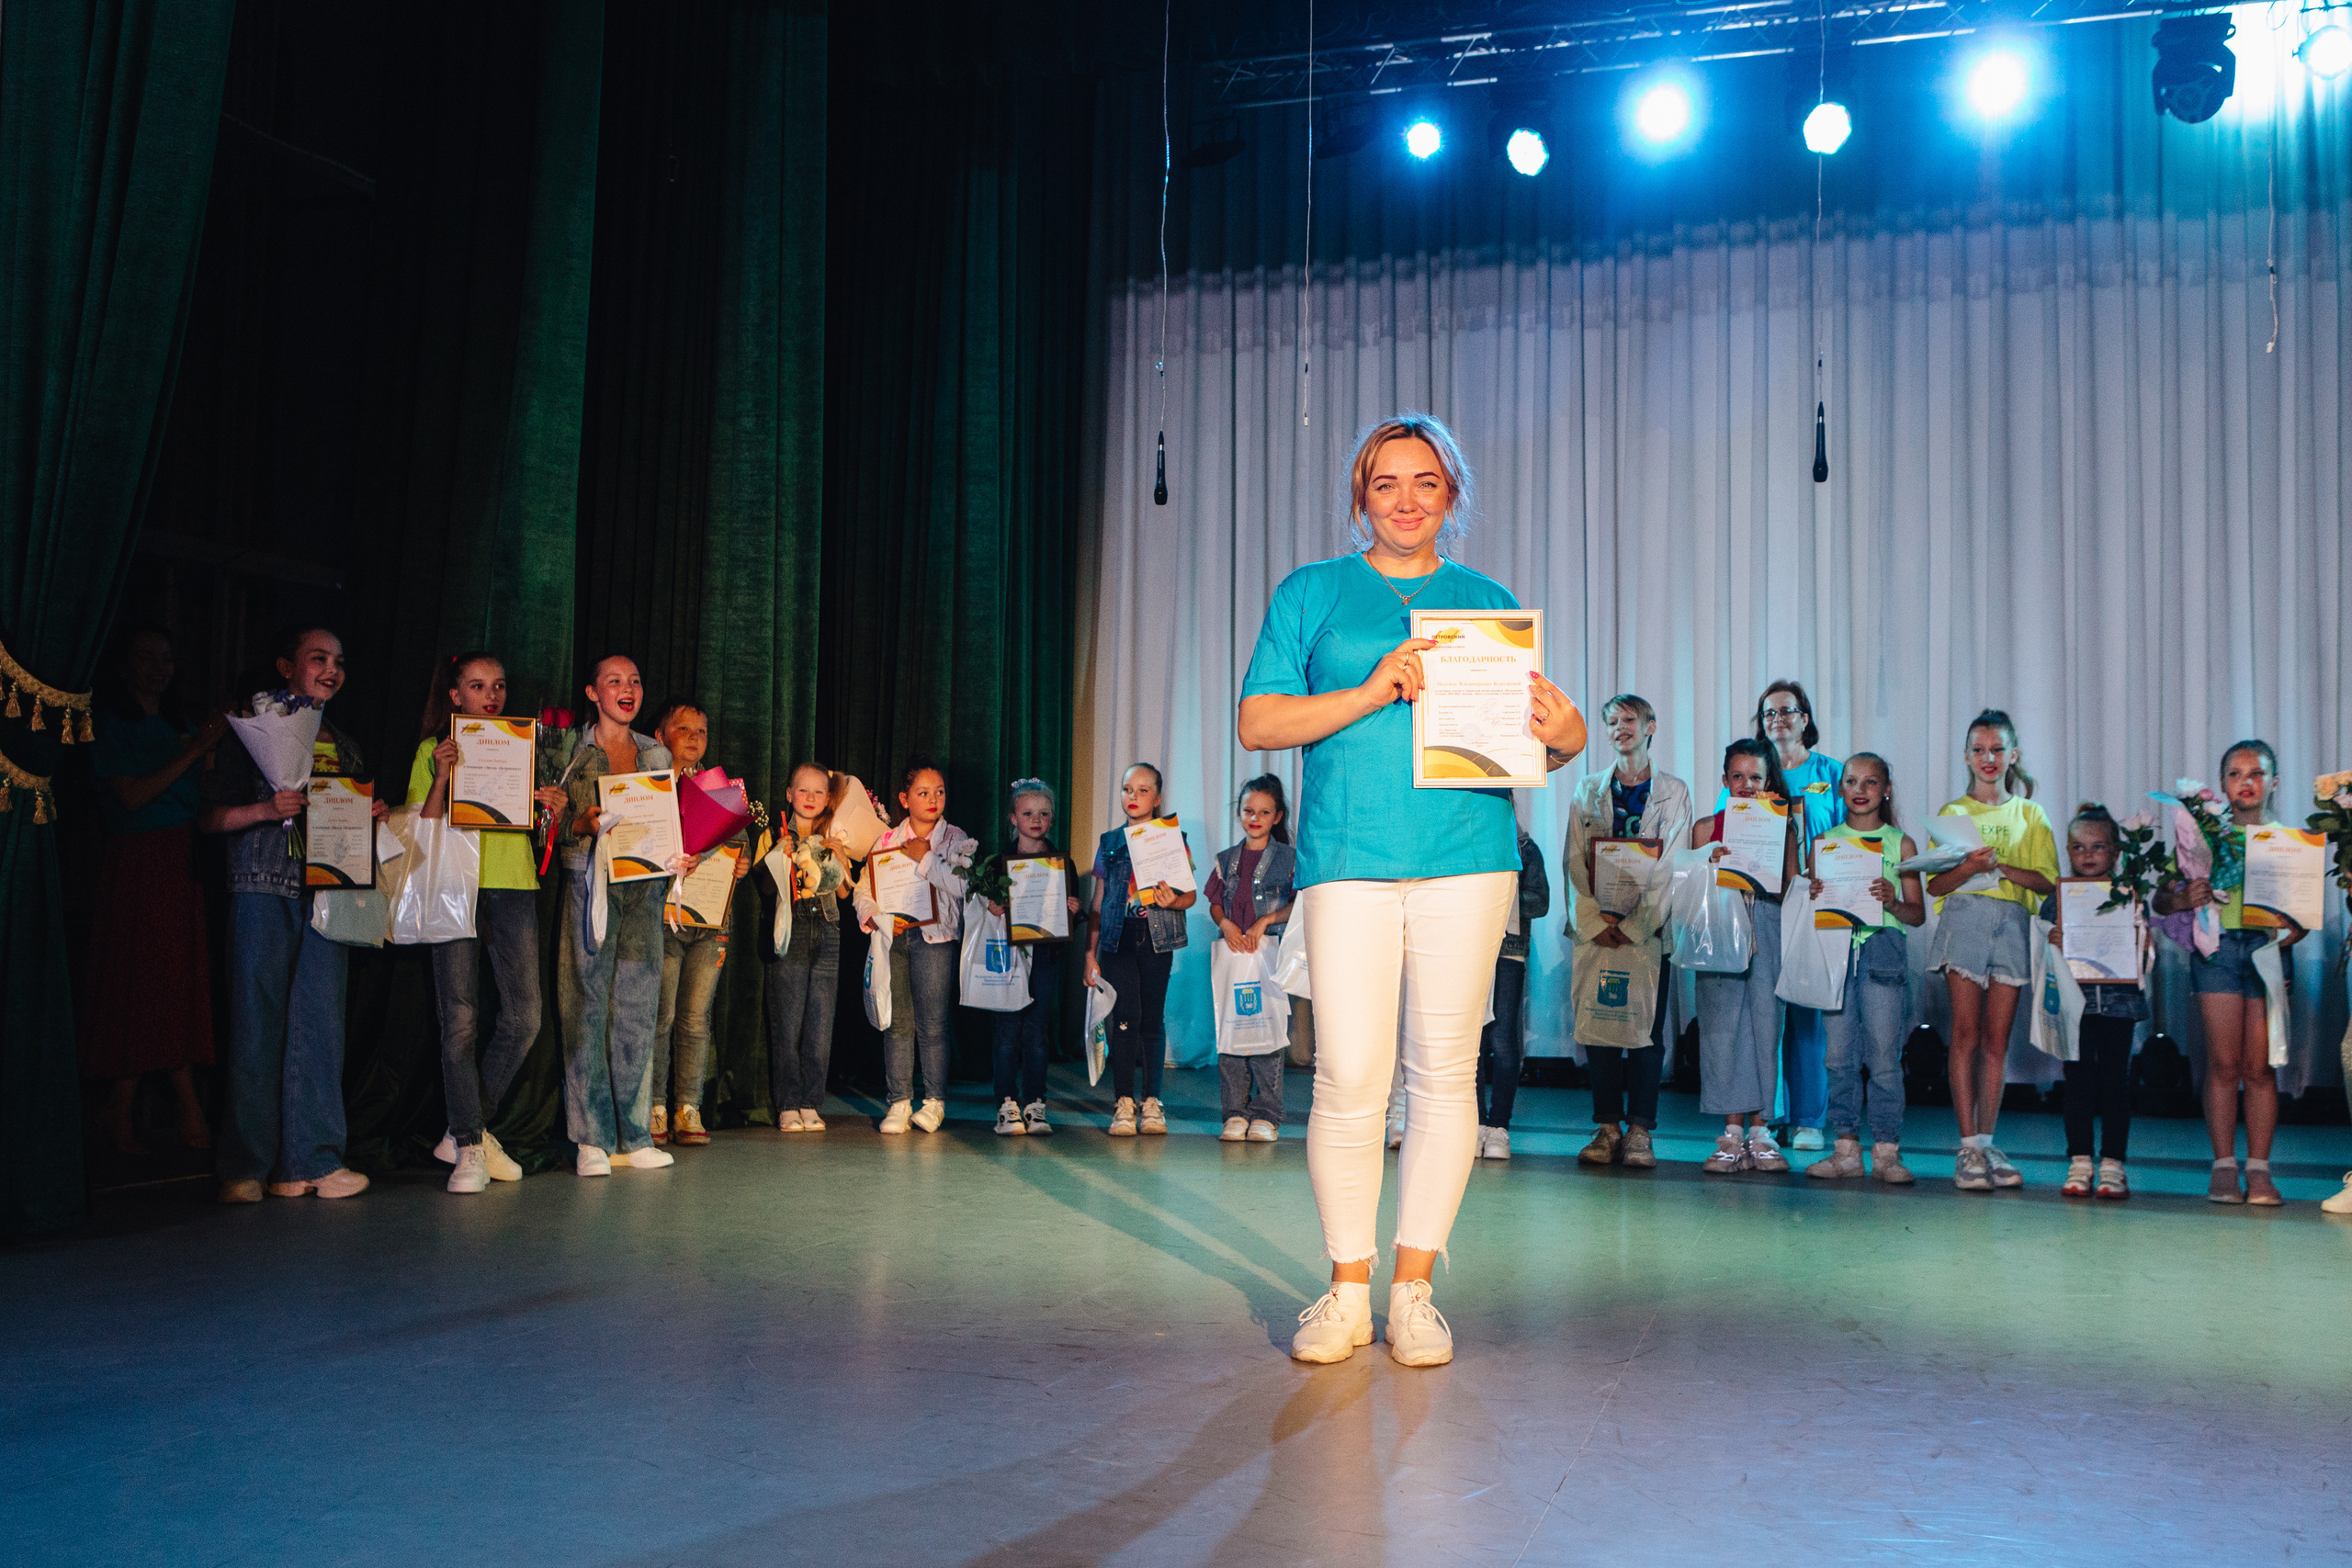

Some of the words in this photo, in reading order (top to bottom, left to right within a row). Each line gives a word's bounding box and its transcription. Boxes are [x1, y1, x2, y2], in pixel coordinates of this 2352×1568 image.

[1440, 655, 1517, 663] БЛАГОДАРНОСТЬ
[624, 795, 653, 804] ДИПЛОМ
[1981, 824, 2010, 836] EXPE
